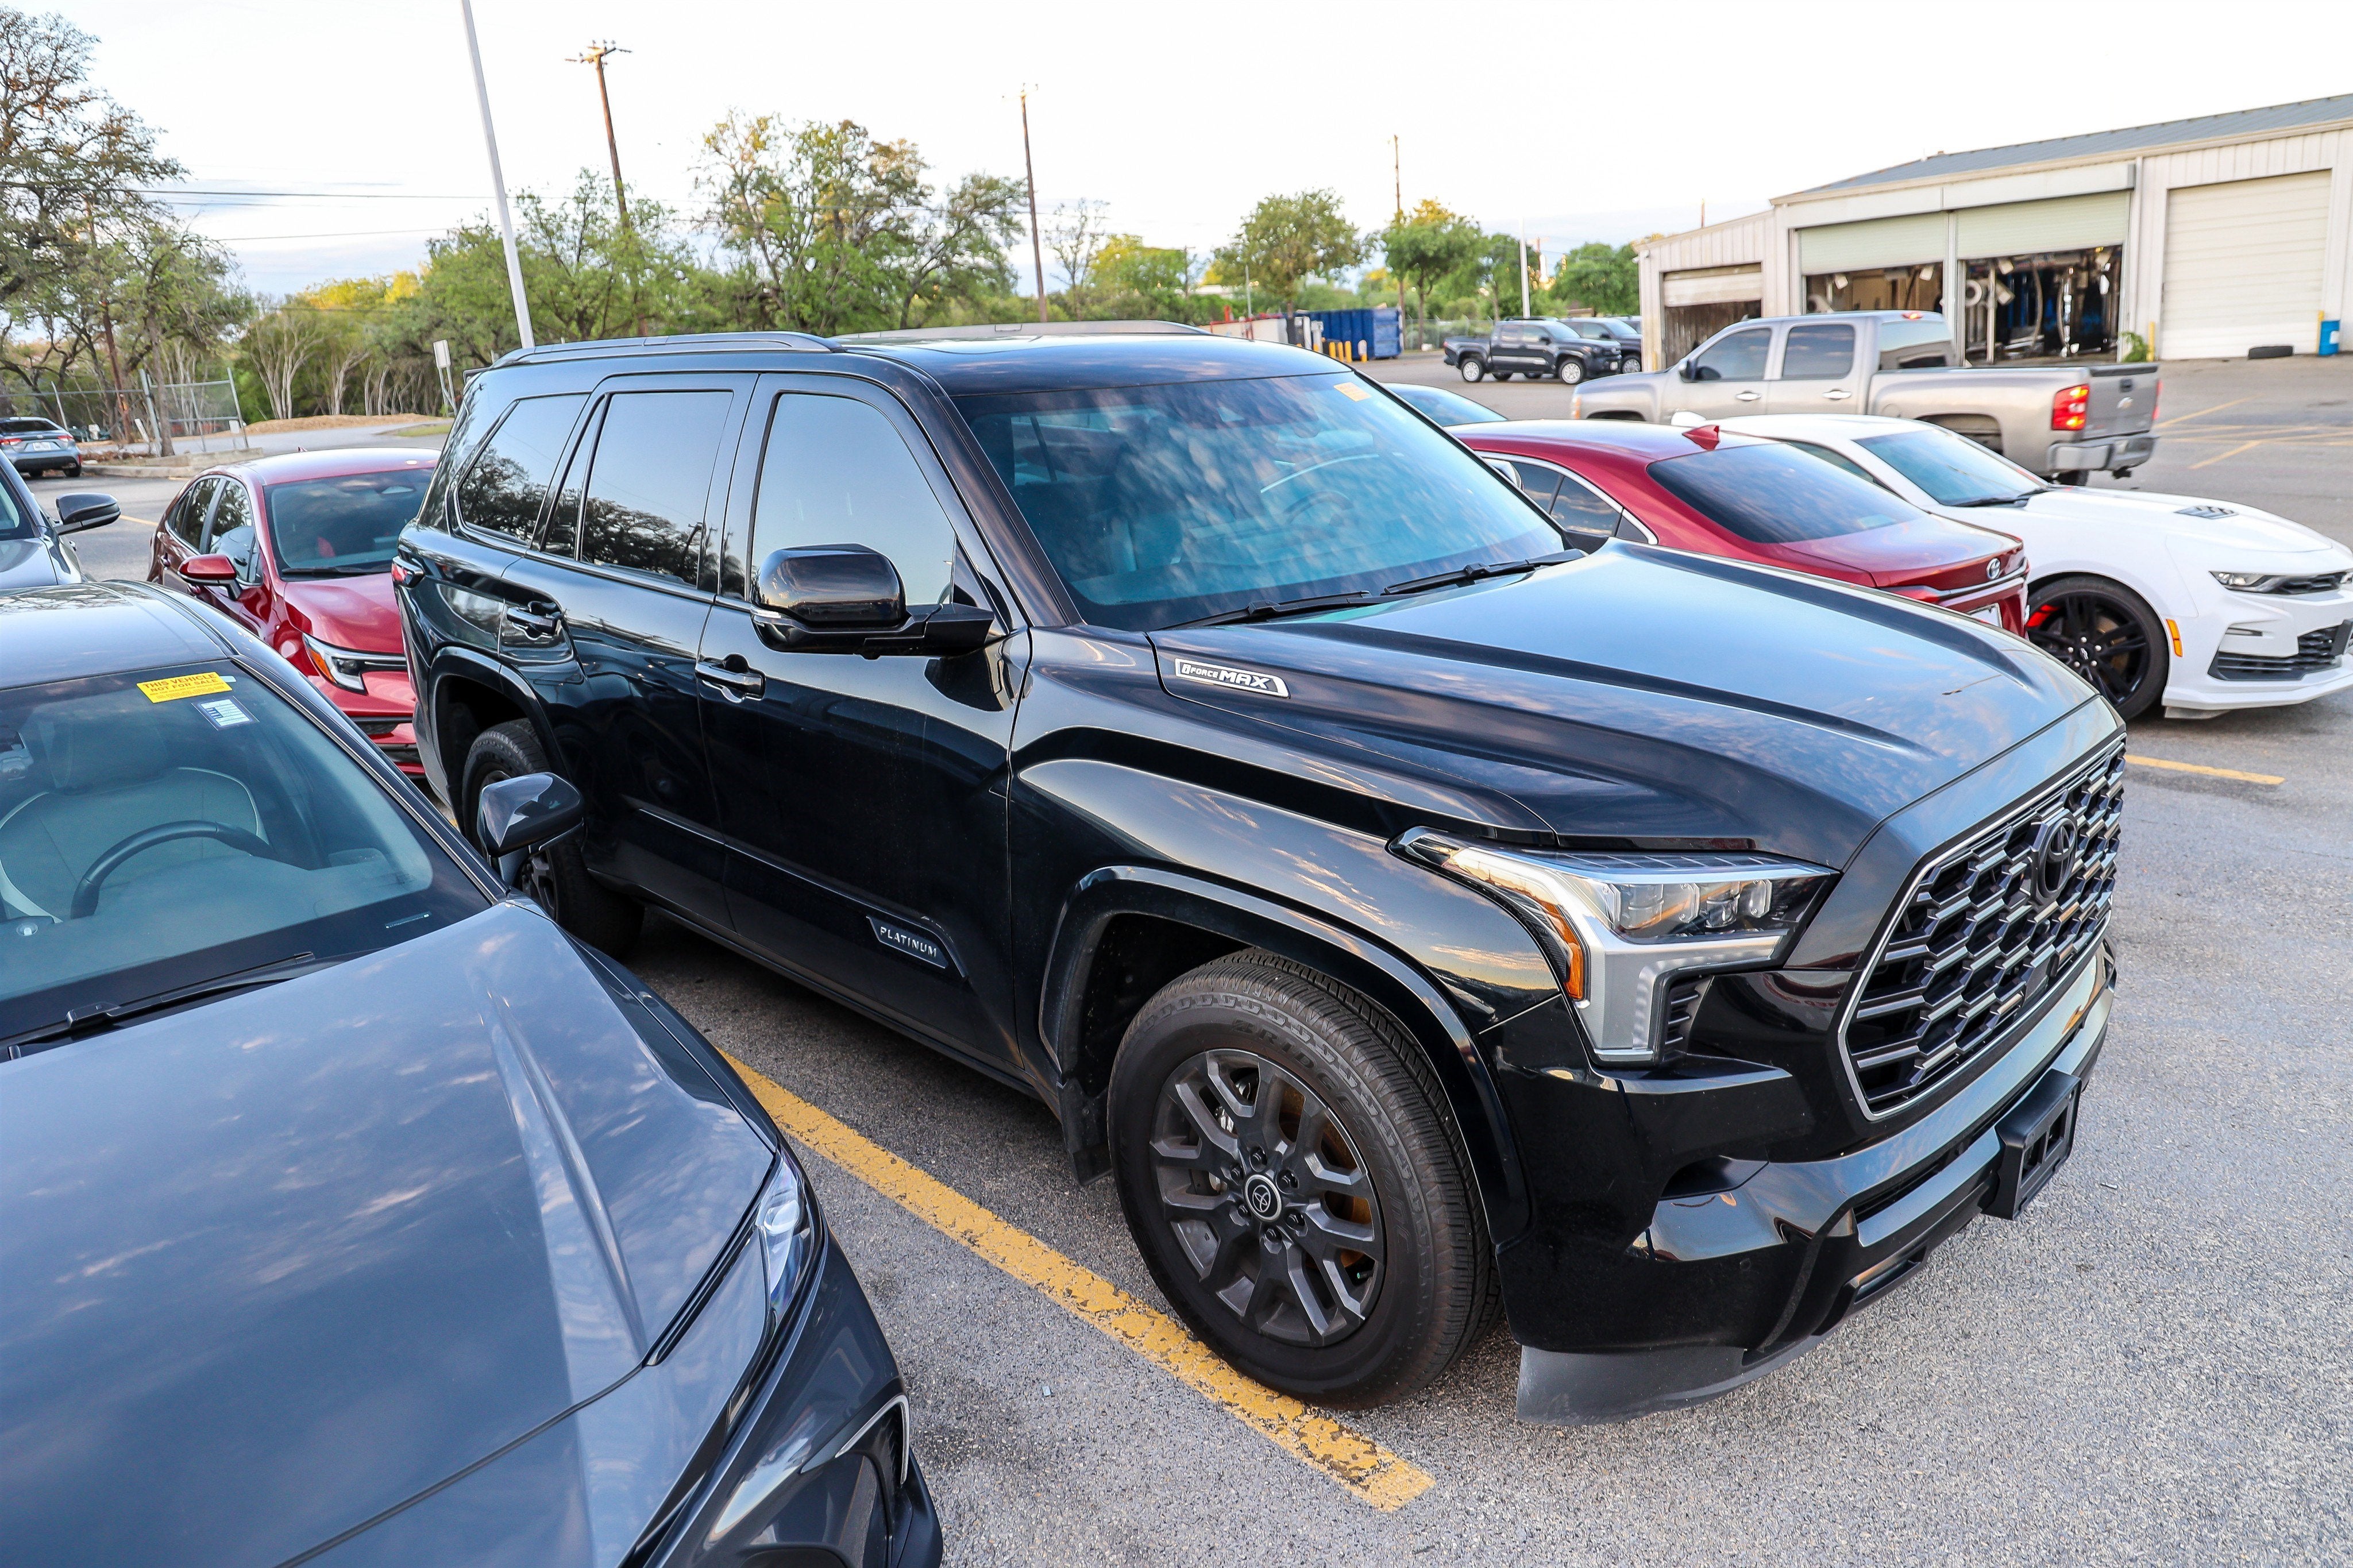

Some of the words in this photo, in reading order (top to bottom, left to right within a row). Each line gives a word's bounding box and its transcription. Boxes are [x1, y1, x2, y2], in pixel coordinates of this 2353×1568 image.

[143, 681, 169, 689] THIS
[171, 673, 217, 683] VEHICLE
[1218, 670, 1270, 689] MAX
[880, 926, 936, 957] PLATINUM
